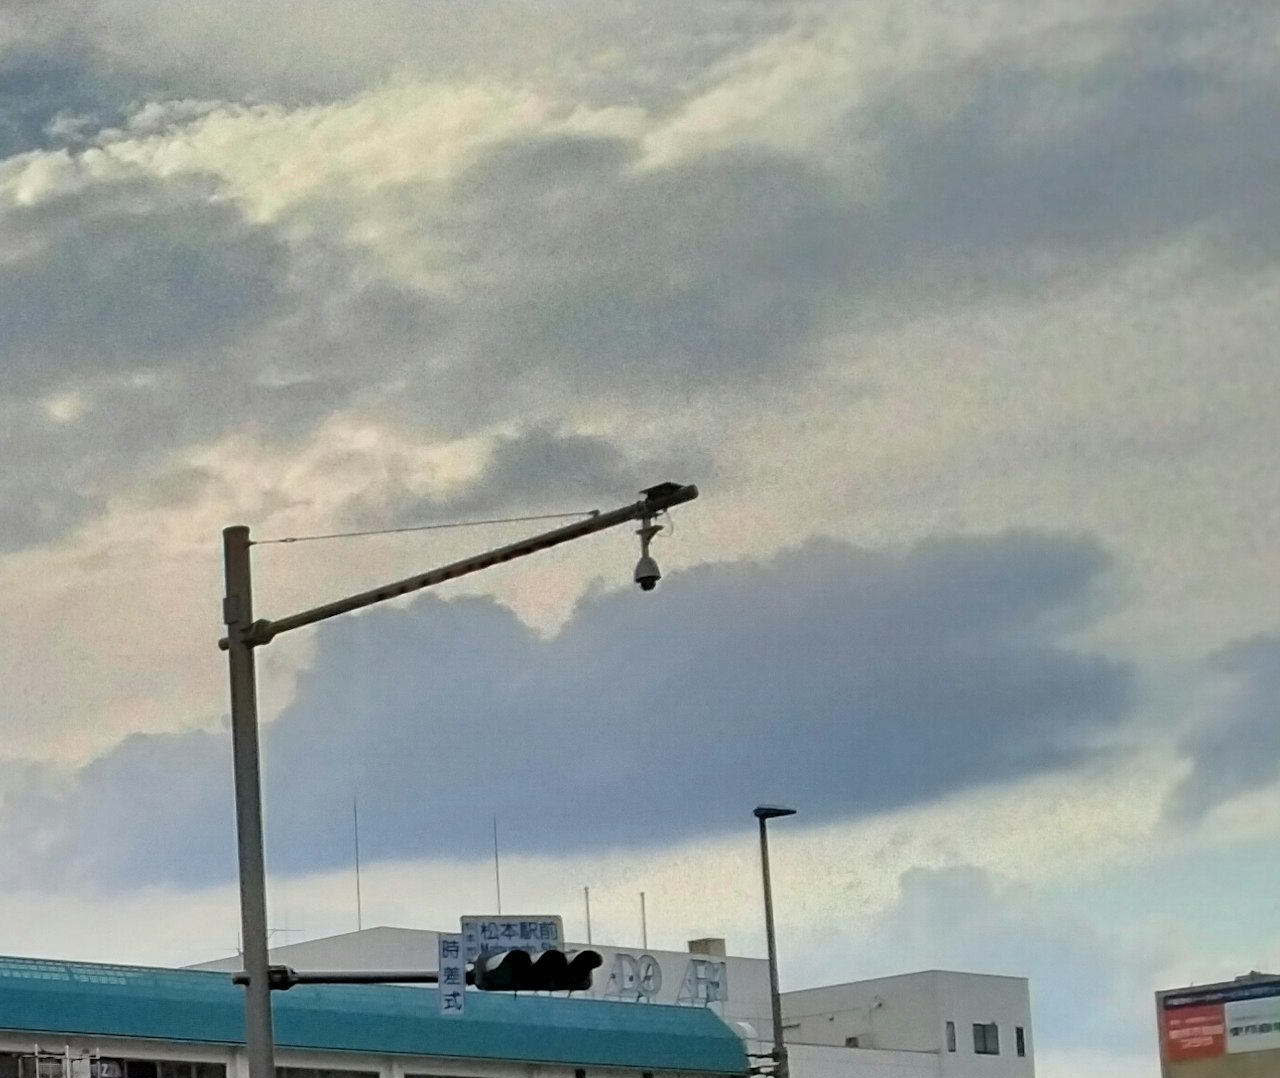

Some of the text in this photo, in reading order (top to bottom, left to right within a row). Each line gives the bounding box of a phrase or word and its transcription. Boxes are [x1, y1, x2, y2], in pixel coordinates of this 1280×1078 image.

[480, 921, 558, 940] 松本駅前
[442, 940, 462, 1010] 時差式
